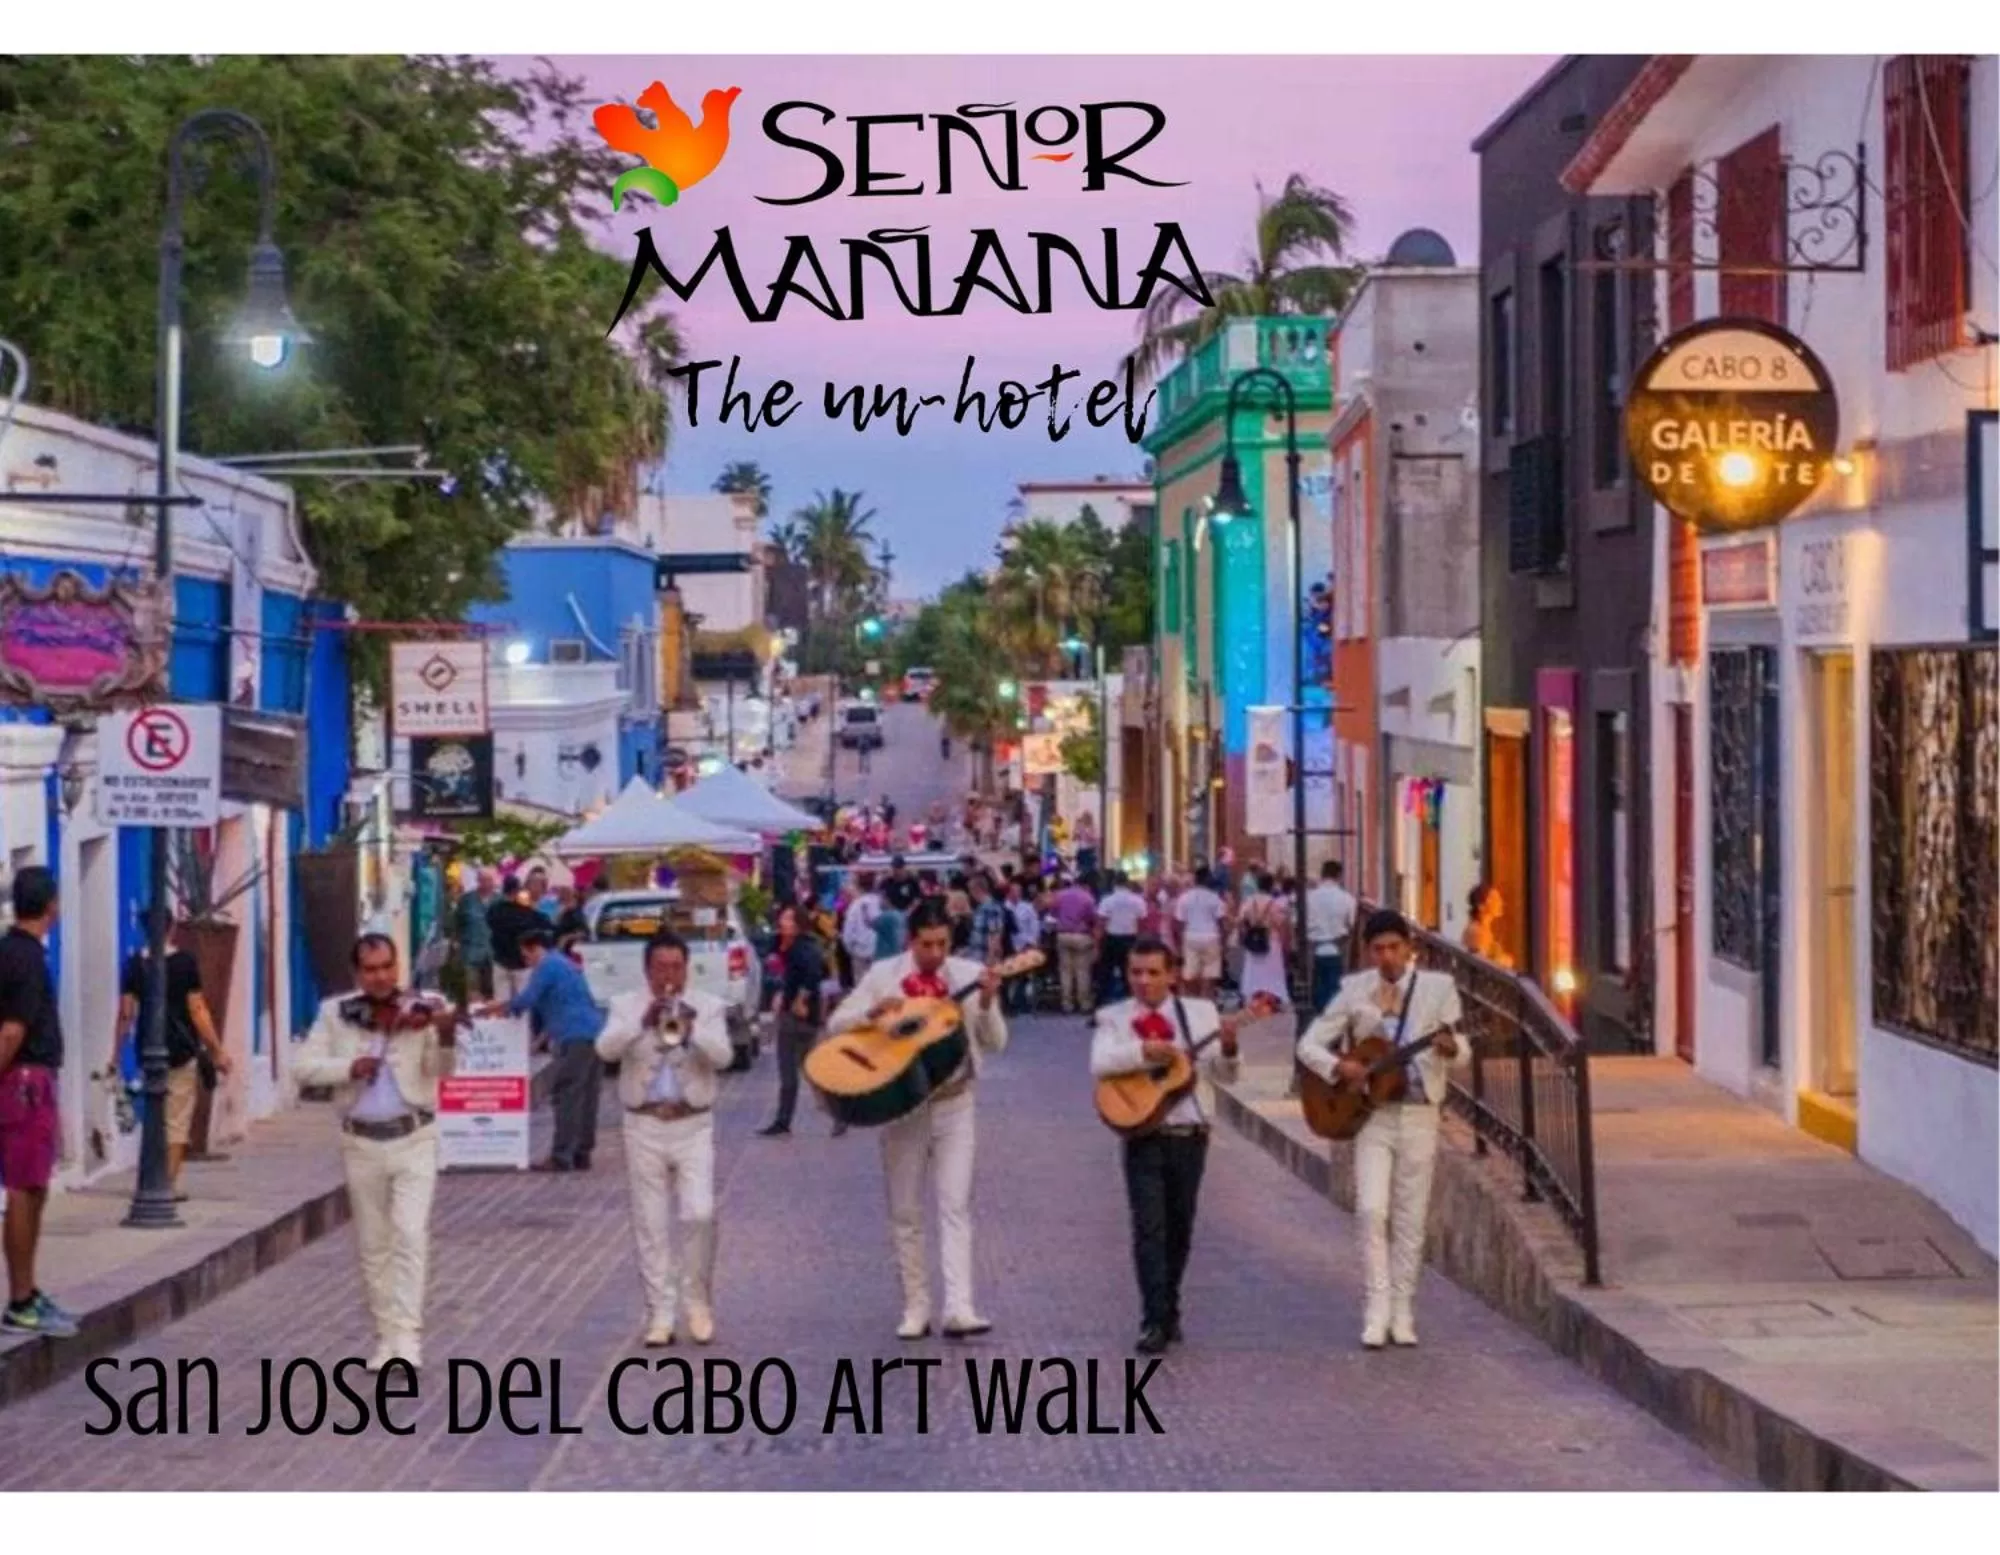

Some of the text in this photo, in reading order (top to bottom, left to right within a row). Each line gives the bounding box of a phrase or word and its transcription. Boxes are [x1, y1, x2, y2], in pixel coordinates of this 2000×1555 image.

[1681, 355, 1789, 380] CABO 8
[1651, 412, 1814, 451] GALERÍA
[1651, 461, 1697, 485] DE
